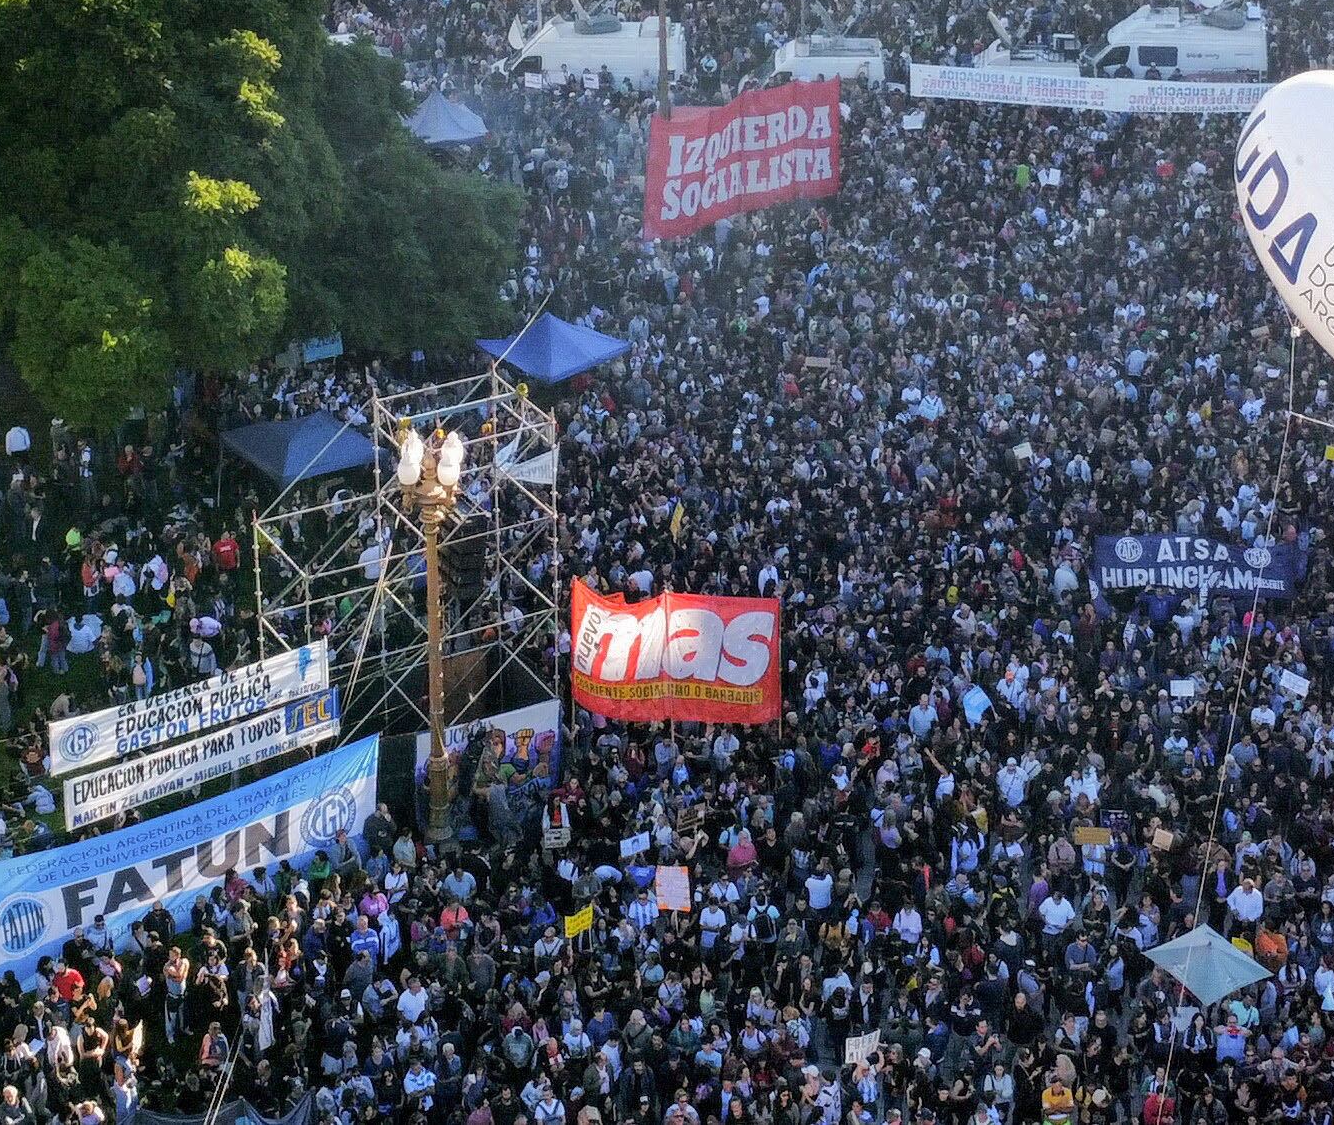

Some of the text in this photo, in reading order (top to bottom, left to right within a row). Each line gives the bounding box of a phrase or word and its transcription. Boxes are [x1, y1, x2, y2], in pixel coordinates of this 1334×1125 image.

[667, 105, 832, 177] IZQUIERDA
[660, 146, 832, 221] SOCIALISTA
[1234, 110, 1317, 286] UDA
[574, 610, 603, 671] nuevo
[118, 703, 137, 719] EN
[221, 671, 240, 686] DE
[246, 661, 265, 675] LA
[117, 695, 267, 755] GASTON FRUTOS
[203, 735, 235, 762] PARA
[287, 695, 331, 731] SEC
[238, 756, 250, 766] DE
[37, 783, 308, 884] DE LAS UNIVERSIDADES NACIONALES
[115, 814, 203, 850] ARGENTINA
[210, 800, 231, 817] DEL
[235, 762, 335, 807] TRABAJADOR
[61, 811, 291, 930] FATUN
[2, 899, 45, 951] FATUN
